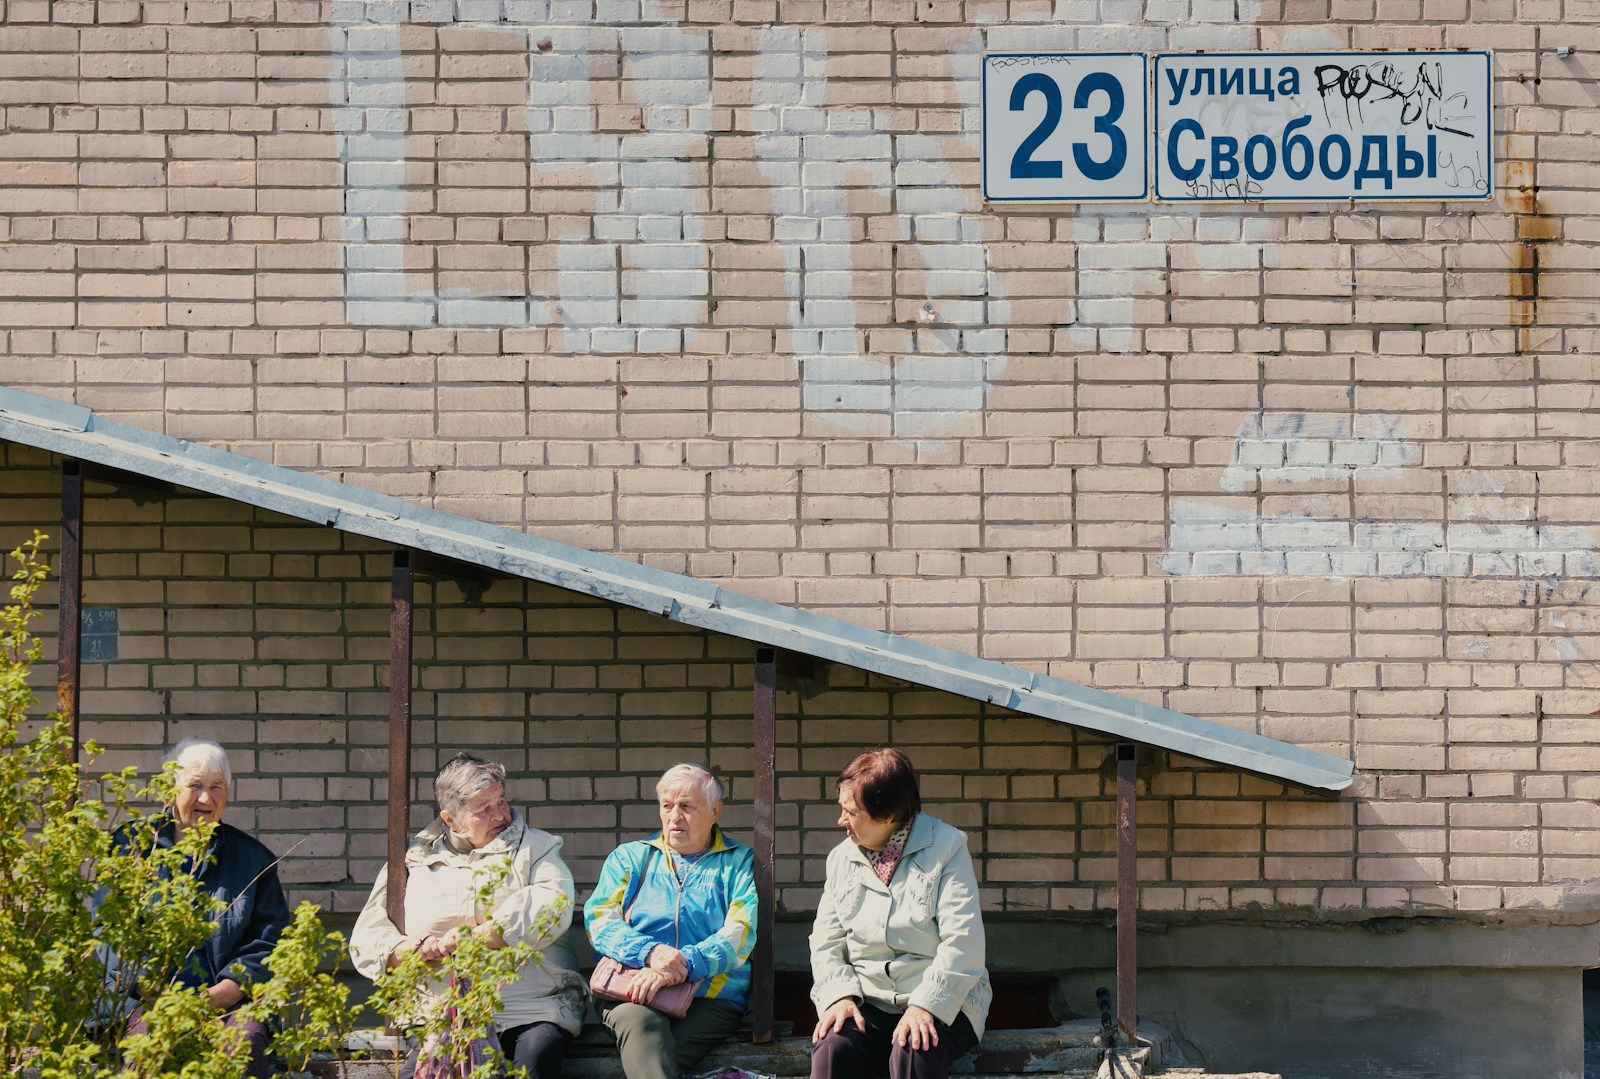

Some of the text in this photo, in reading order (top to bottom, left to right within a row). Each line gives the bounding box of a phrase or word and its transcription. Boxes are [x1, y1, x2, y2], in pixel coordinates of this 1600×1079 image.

[1166, 67, 1299, 105] улица
[1010, 72, 1126, 181] 23
[1168, 116, 1436, 189] Свободы
